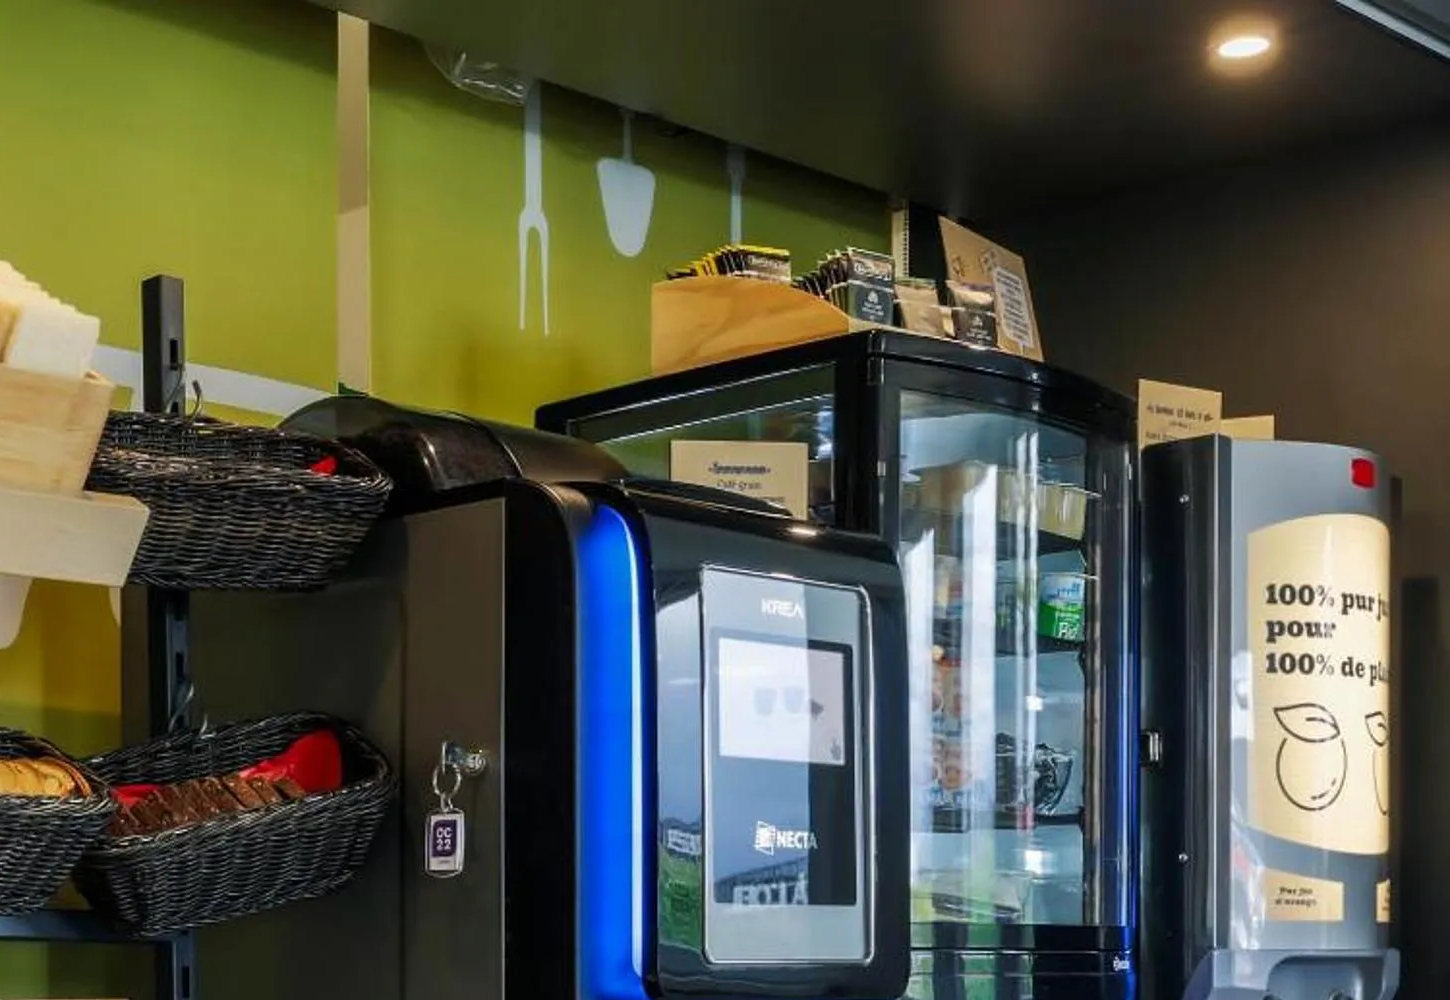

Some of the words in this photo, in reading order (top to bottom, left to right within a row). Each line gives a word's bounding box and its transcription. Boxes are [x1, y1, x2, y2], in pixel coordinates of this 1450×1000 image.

[1266, 583, 1335, 607] 100%
[1341, 592, 1375, 615] pur
[1376, 593, 1389, 622] ju
[1266, 619, 1336, 644] pour
[1266, 652, 1335, 675] 100%
[1341, 656, 1366, 678] de
[436, 839, 452, 851] 22
[776, 829, 819, 849] NECTA
